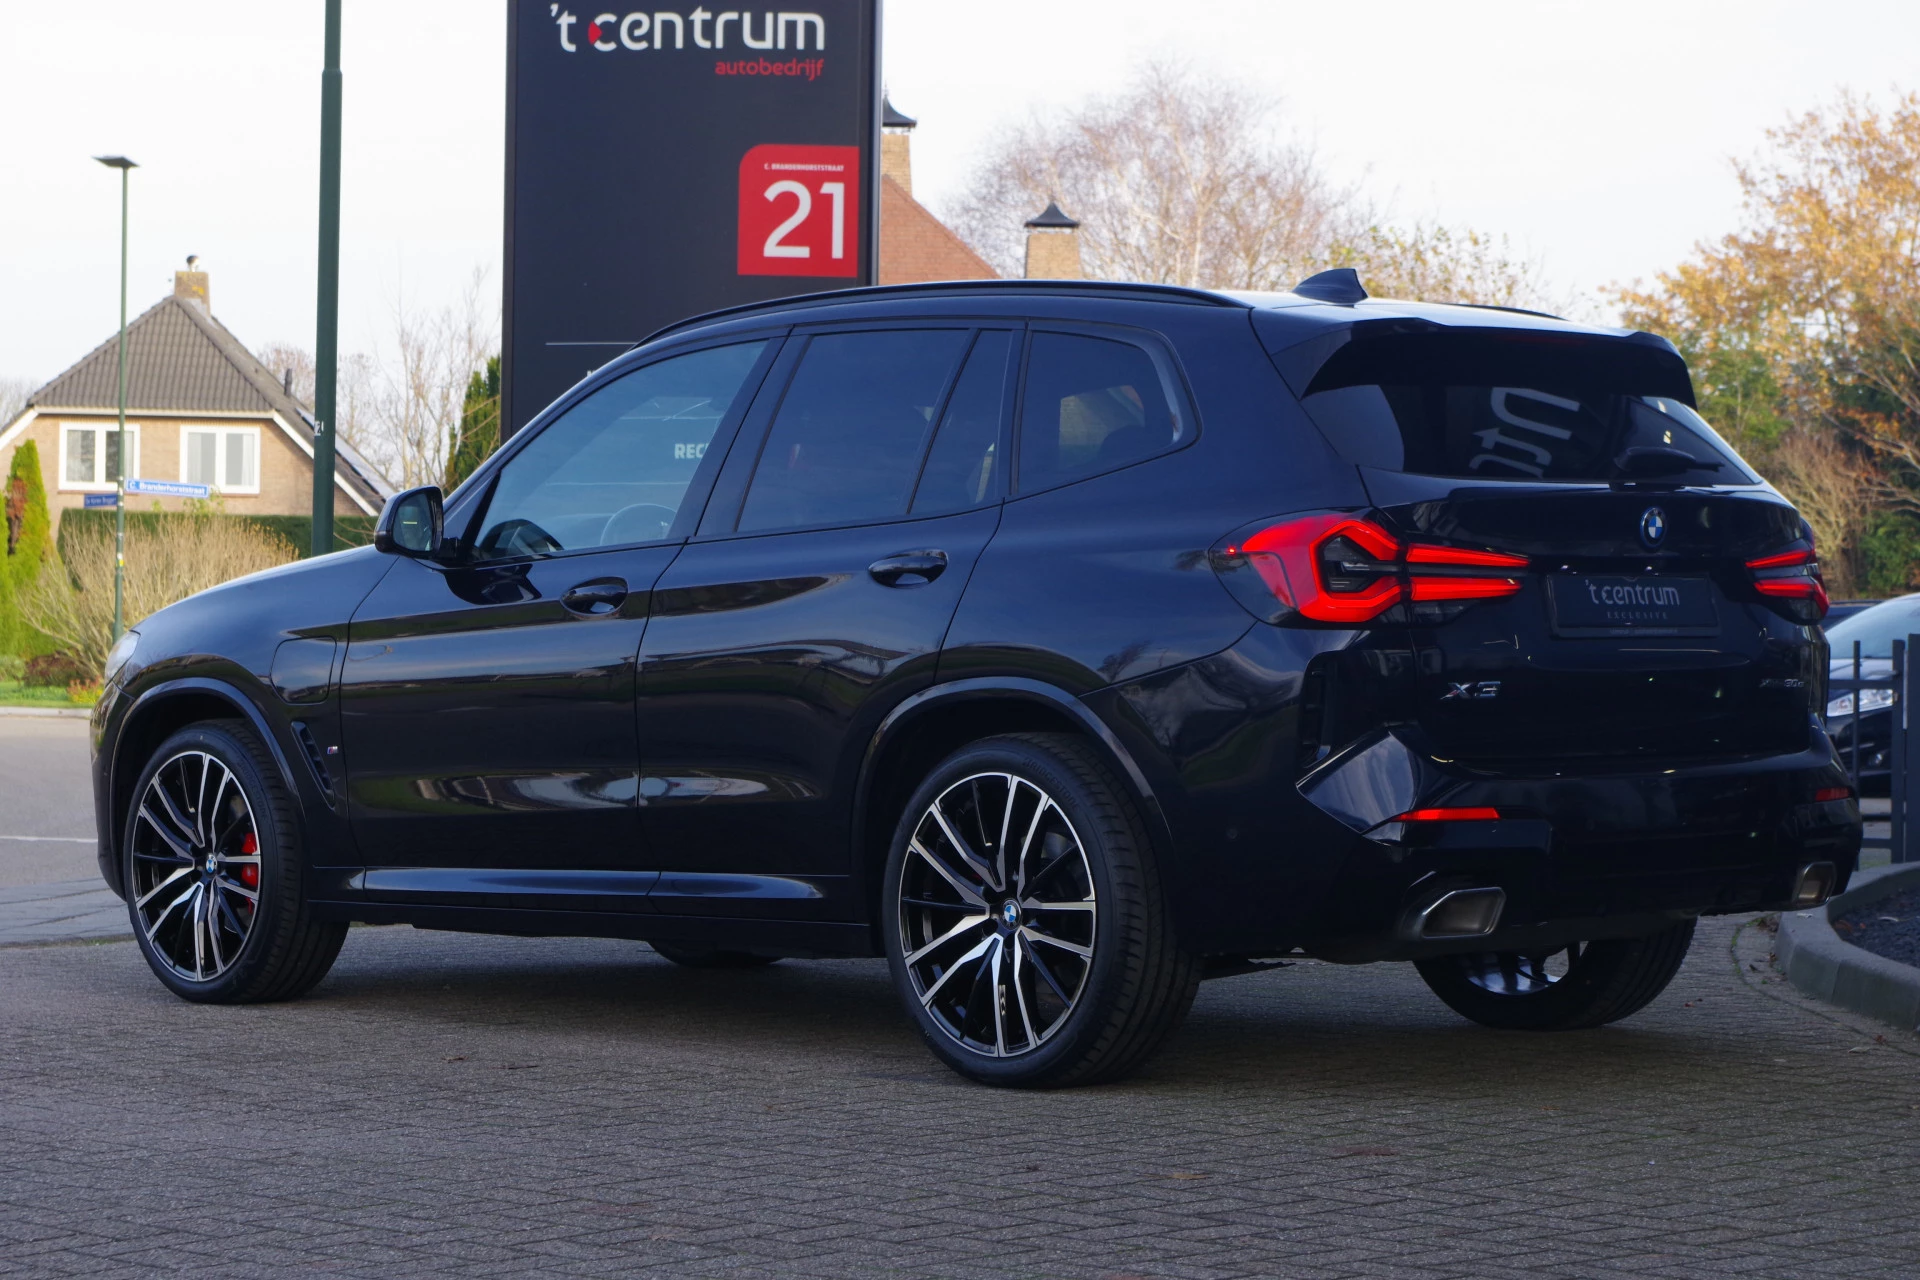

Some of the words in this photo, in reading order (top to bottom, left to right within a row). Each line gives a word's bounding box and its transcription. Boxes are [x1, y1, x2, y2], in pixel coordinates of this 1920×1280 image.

[588, 6, 826, 52] centrum
[715, 58, 825, 81] autobedrijf
[763, 180, 845, 260] 21
[674, 443, 709, 459] REC
[1601, 584, 1681, 606] centrum
[1606, 611, 1669, 620] EXCLUSIVE
